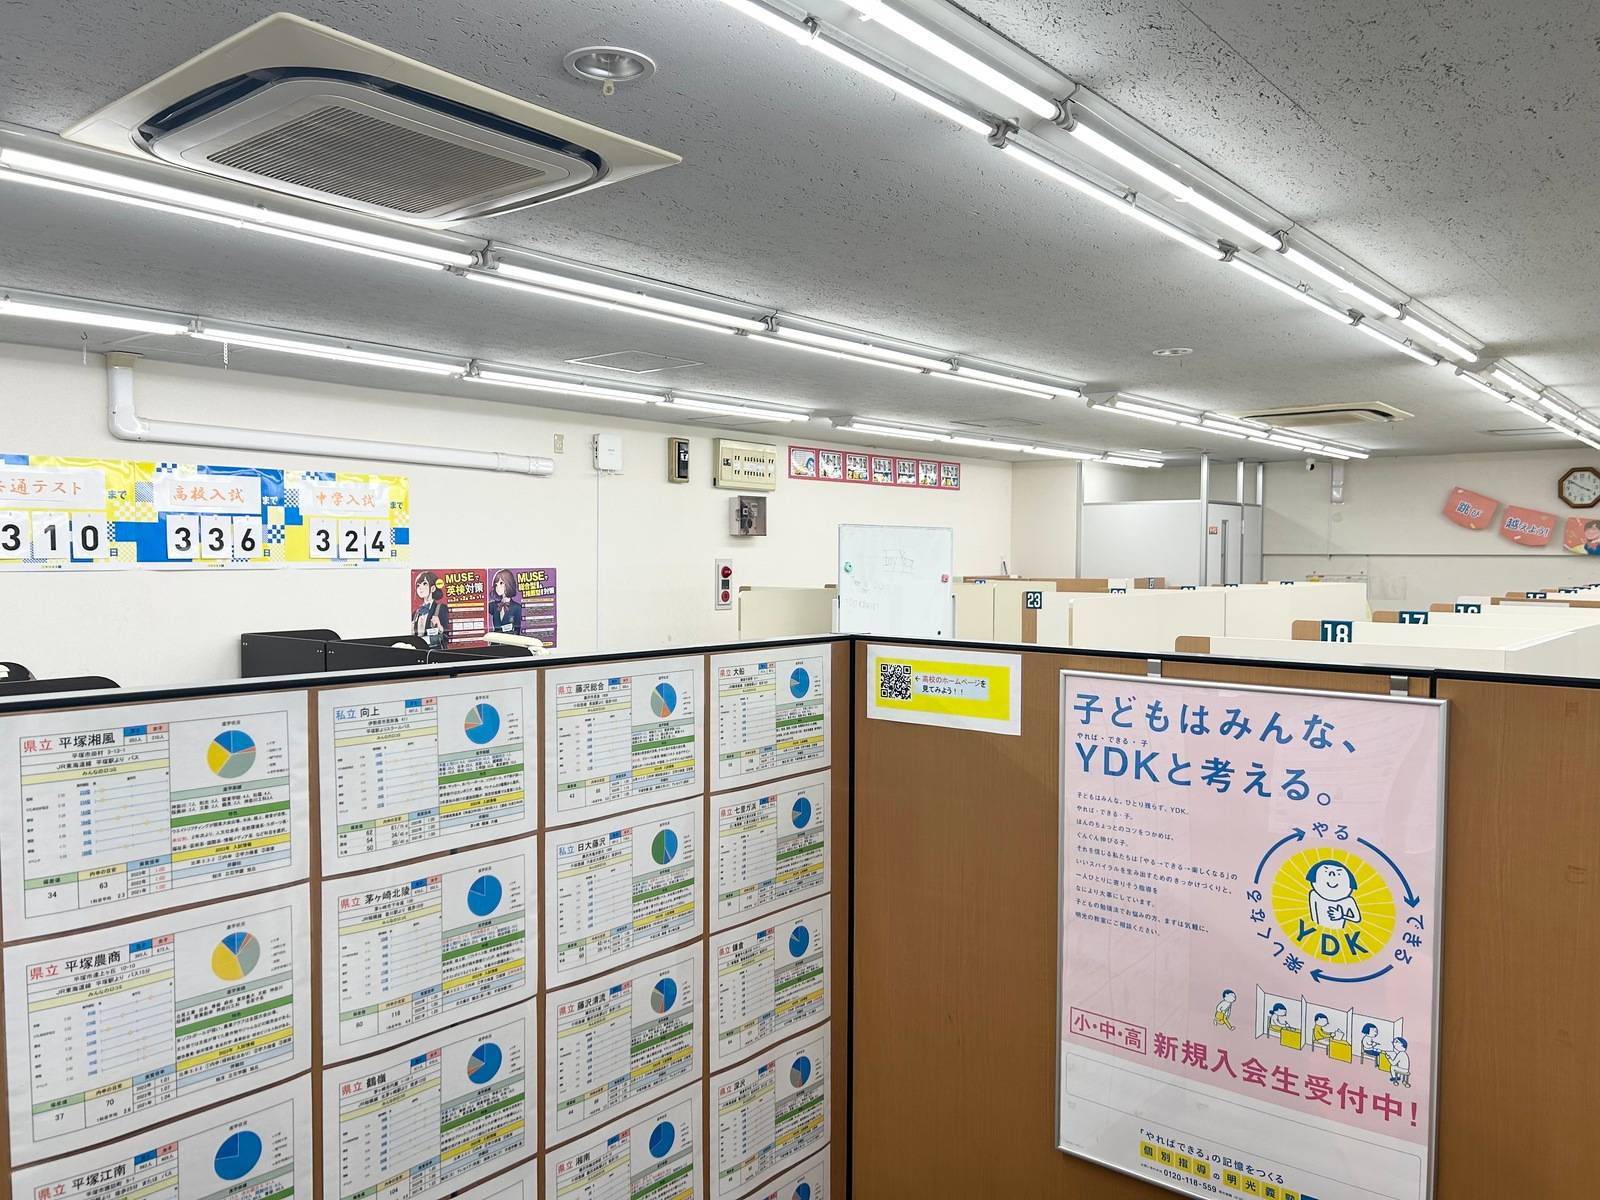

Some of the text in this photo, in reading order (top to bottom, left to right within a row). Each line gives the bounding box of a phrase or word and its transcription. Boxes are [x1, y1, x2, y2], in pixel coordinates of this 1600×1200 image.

[108, 489, 127, 500] まで
[171, 484, 244, 503] 高校入試
[262, 496, 278, 506] まで
[316, 492, 376, 508] 中学入試
[390, 500, 403, 510] まで
[0, 523, 99, 552] 310
[174, 527, 256, 552] 336
[315, 529, 385, 552] 324
[110, 548, 118, 557] 日
[264, 548, 270, 557] 日
[390, 549, 397, 557] 日
[446, 583, 484, 596] 英検対策
[1027, 593, 1040, 608] 23
[1324, 624, 1349, 642] 18
[558, 682, 604, 695] 県立 藤沢総合
[922, 675, 986, 688] 高校のホームページを
[336, 706, 380, 720] 私立 向上
[1073, 692, 1356, 753] 子どもはみんな、
[23, 732, 116, 752] 県立 平塚湘風
[1075, 742, 1332, 806] YDKと考える。
[1312, 822, 1348, 840] やる
[578, 837, 606, 851] 日大藤沢
[341, 896, 361, 909] 県立
[1247, 890, 1304, 974] 楽しくなる
[1297, 919, 1368, 956] YDK
[1395, 915, 1424, 964] できる
[30, 951, 121, 980] 県立 平塚農商
[1074, 1014, 1142, 1049] 小・中・高
[342, 1082, 362, 1096] 県立
[55, 1113, 64, 1121] 37
[1140, 1128, 1284, 1184] 「やればできる」の記憶をつくる
[38, 1164, 126, 1200] 県立 平塚江南
[1164, 1169, 1217, 1192] 0120-118-559
